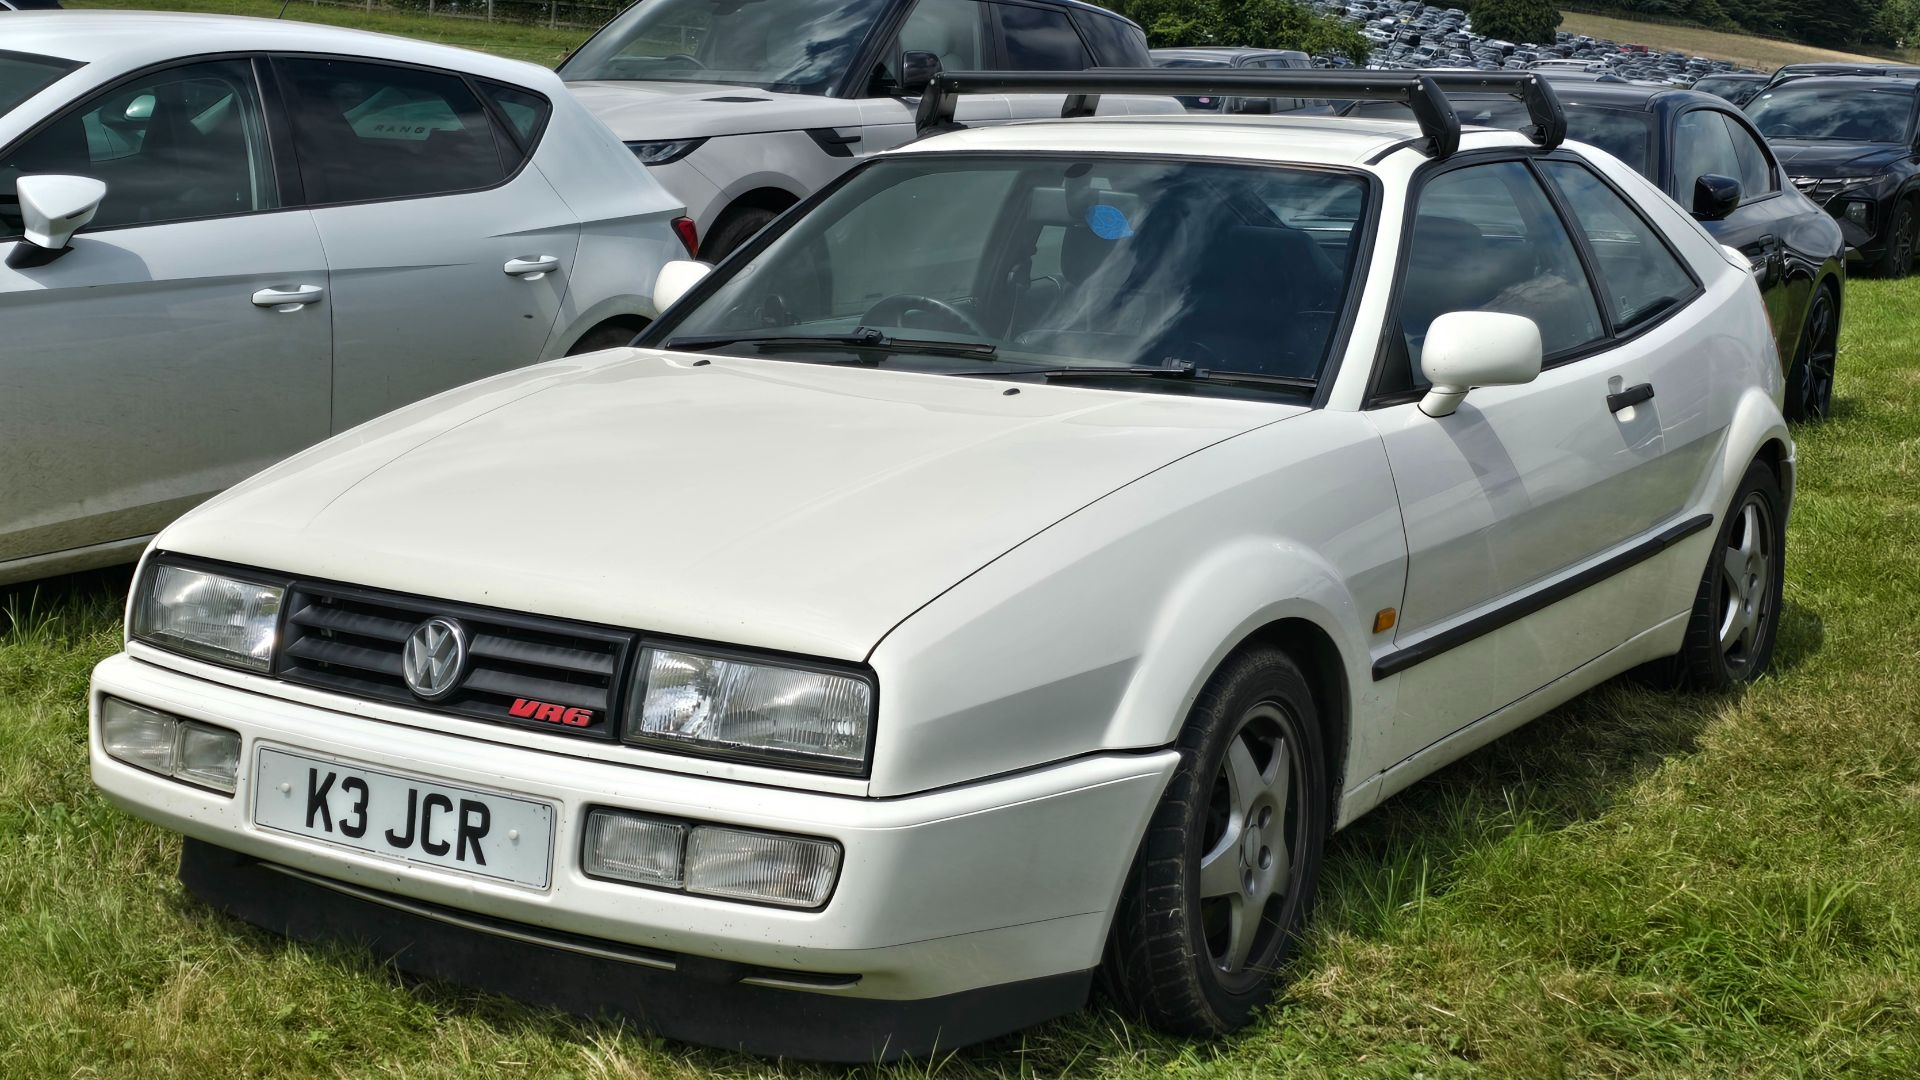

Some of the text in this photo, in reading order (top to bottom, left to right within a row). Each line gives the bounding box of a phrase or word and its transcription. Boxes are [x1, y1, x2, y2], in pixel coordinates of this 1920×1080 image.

[374, 124, 440, 133] RANG
[508, 698, 593, 727] VR6
[305, 768, 490, 866] K3 JCR
